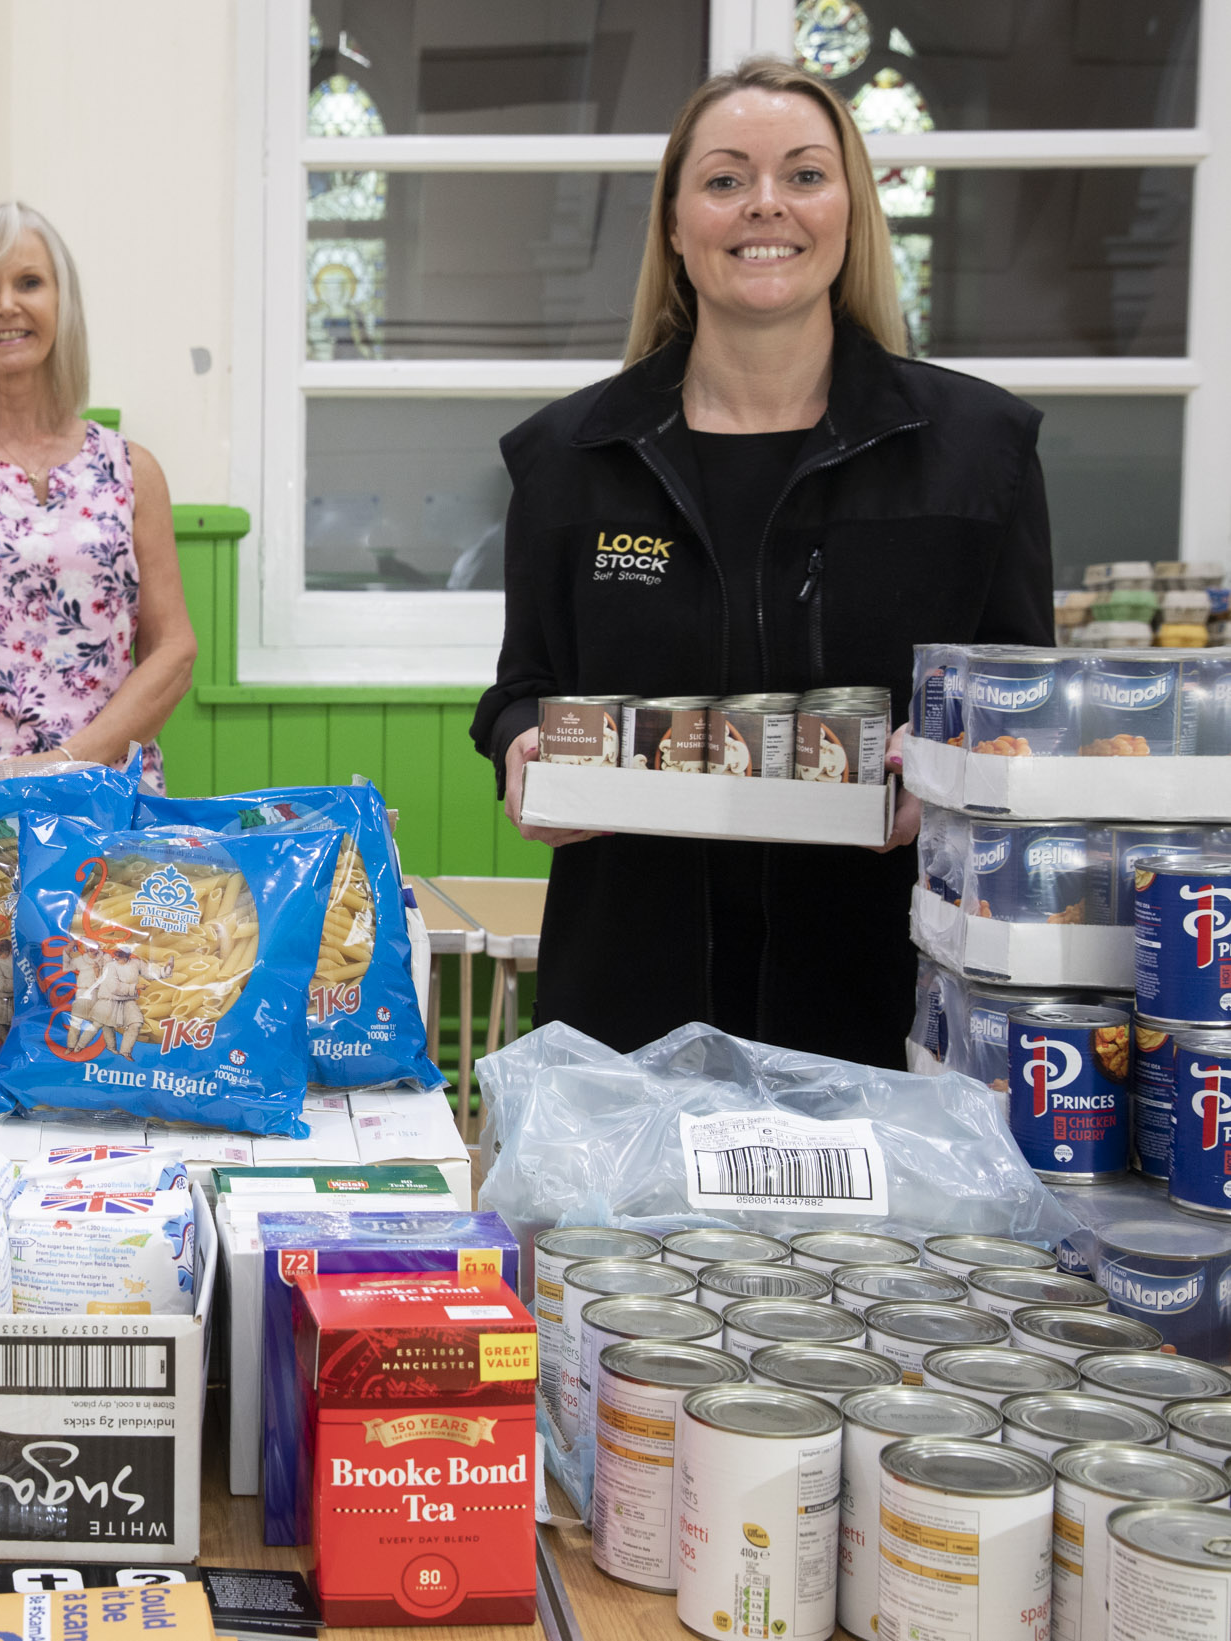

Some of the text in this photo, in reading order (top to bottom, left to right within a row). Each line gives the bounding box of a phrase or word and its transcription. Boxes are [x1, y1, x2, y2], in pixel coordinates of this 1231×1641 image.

[597, 532, 674, 558] LOCK
[595, 554, 668, 573] STOCK
[593, 571, 662, 585] Self Storage
[986, 680, 1048, 709] Napoli
[1102, 680, 1167, 707] Napoli
[547, 735, 597, 744] MUSHROOMS
[132, 905, 199, 925] Le Meraviglie
[140, 917, 187, 934] di Napoli
[310, 983, 361, 1024] 1Kg
[159, 1018, 217, 1055] 1Kg
[366, 1031, 388, 1041] 1000g
[312, 1039, 372, 1060] Rigate
[219, 1064, 241, 1073] cottura
[83, 1062, 218, 1096] Penne Rigate
[214, 1070, 238, 1084] 1000g
[1051, 1094, 1115, 1109] PRINCES
[1056, 1116, 1116, 1137] HOT CHICKEN
[1069, 1129, 1105, 1141] CURRY
[736, 1196, 823, 1206] 05000144347882
[285, 1254, 309, 1269] 72
[339, 1286, 481, 1297] Brooke Bond
[393, 1294, 434, 1302] Tea
[1126, 1278, 1199, 1310] Napoli
[2, 1324, 48, 1335] 15233
[62, 1324, 108, 1335] 20379
[121, 1325, 149, 1335] 050
[432, 1348, 465, 1356] 1869
[382, 1361, 475, 1370] MANCHESTER
[487, 1358, 530, 1368] VALUE
[71, 1400, 175, 1409] Store in cool, dry place.
[63, 1418, 176, 1428] Individual 2g sticks
[391, 1418, 469, 1434] 150 YEARS
[330, 1455, 527, 1487] Brooke Bond
[402, 1495, 456, 1522] Tea
[89, 1521, 168, 1537] WHITE
[419, 1536, 439, 1544] DAY
[444, 1535, 480, 1543] BLEND
[740, 1547, 758, 1560] 410g
[419, 1570, 441, 1584] 80
[102, 1602, 136, 1622] be
[139, 1588, 177, 1630] Could
